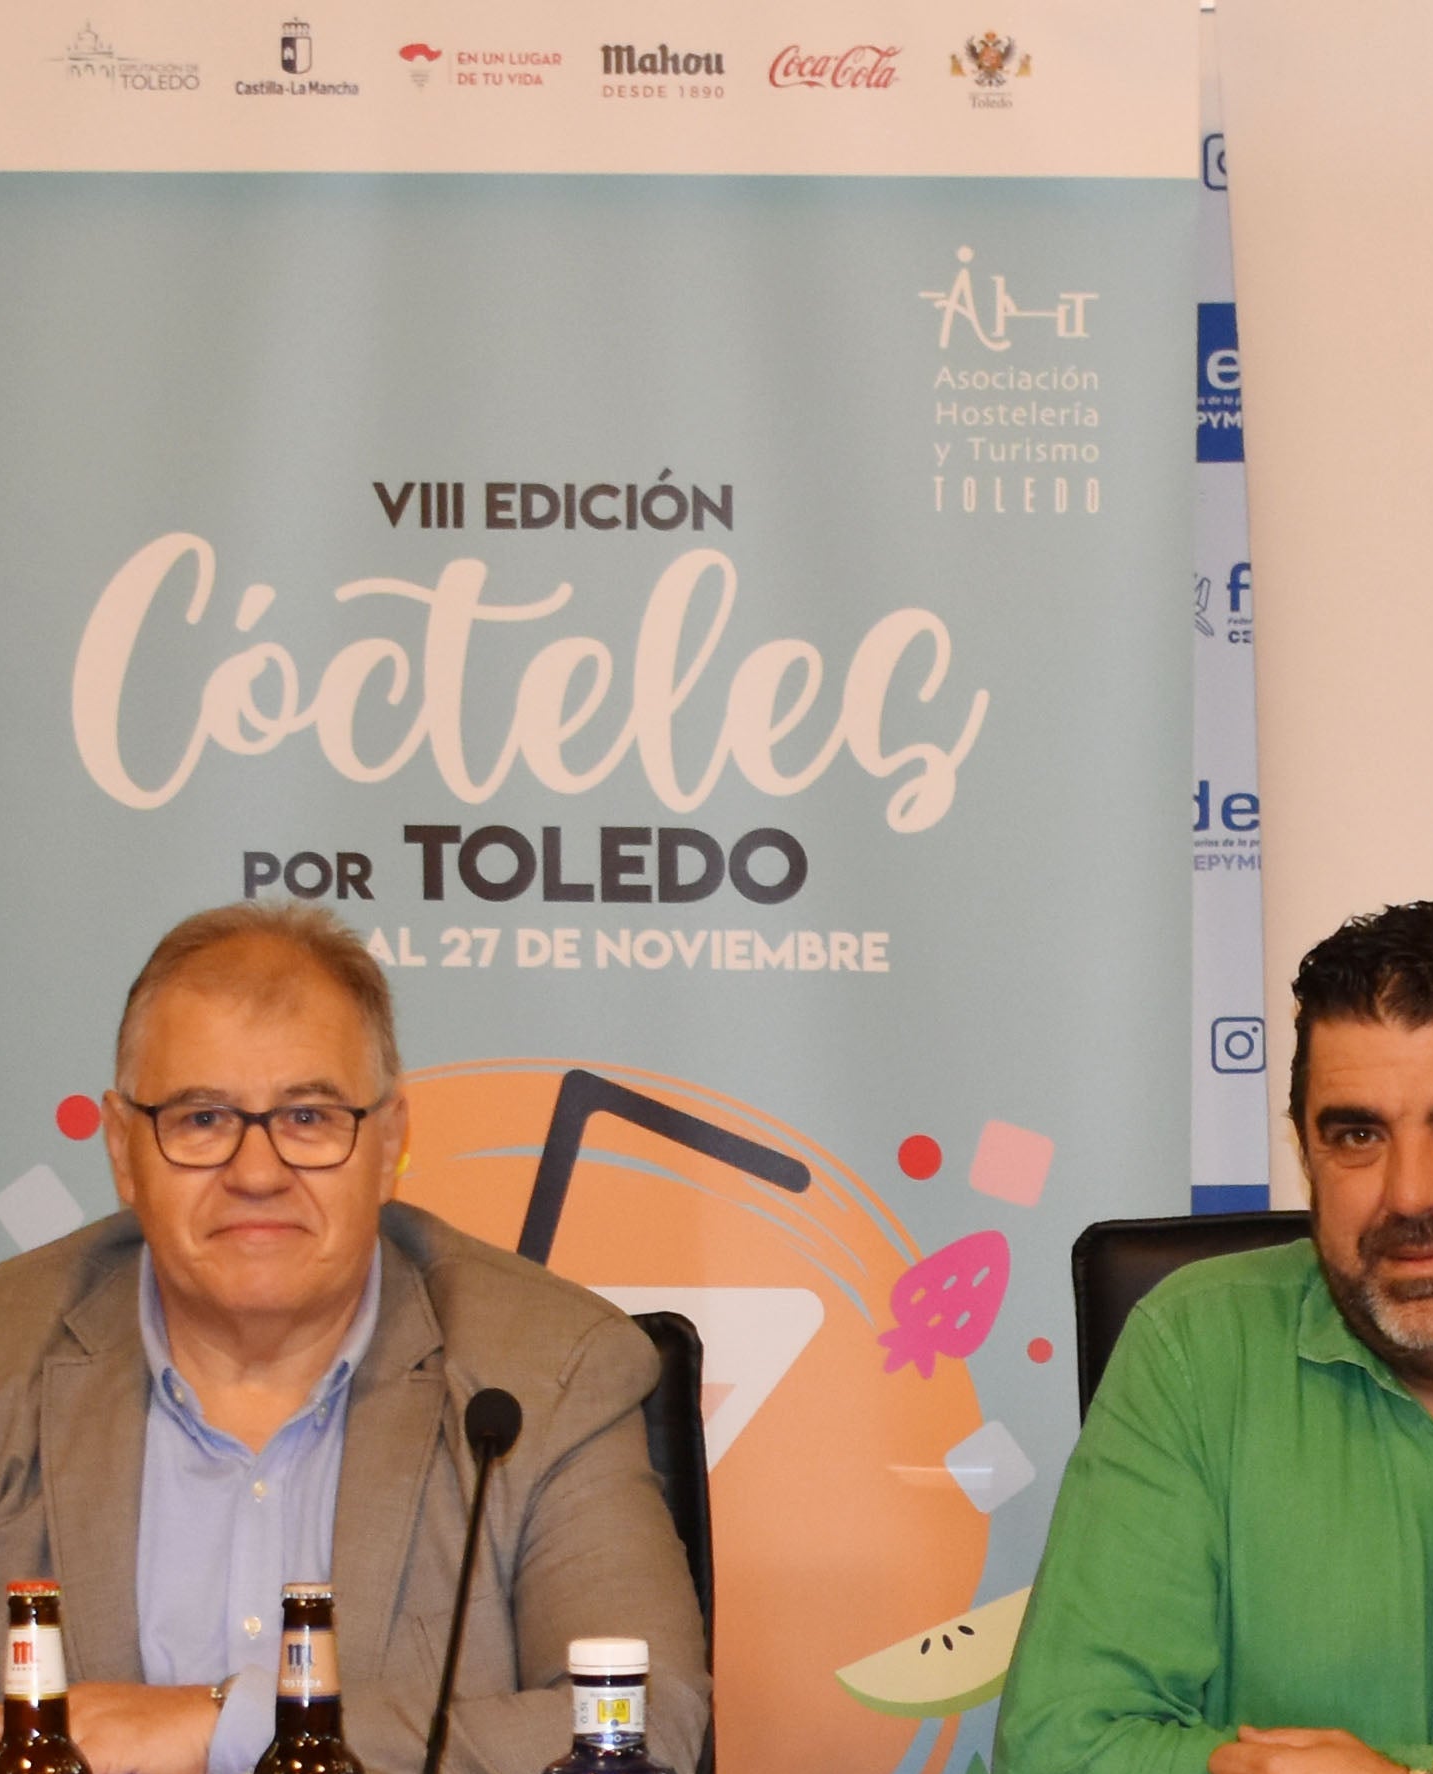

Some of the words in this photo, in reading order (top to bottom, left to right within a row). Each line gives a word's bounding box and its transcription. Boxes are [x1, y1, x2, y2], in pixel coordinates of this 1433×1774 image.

[457, 52, 478, 64] EN
[482, 52, 504, 65] UN
[509, 52, 562, 65] LUGAR
[601, 44, 724, 75] Mahou
[768, 44, 905, 89] Coca-Cola
[121, 74, 200, 91] TOLEDO
[308, 81, 360, 96] Mancha
[457, 72, 477, 85] DE
[482, 72, 503, 86] TU
[507, 73, 543, 86] VIDA
[602, 85, 666, 98] DESDE
[679, 85, 724, 99] 1890
[934, 365, 1098, 391] Asociación
[936, 402, 1099, 427] Hostelería
[934, 443, 950, 467] y
[967, 437, 1099, 463] Turismo
[373, 482, 464, 528] VIII
[485, 468, 732, 530] EDICIÓN
[934, 476, 1100, 514] TOLEDO
[71, 532, 990, 834] Cócteles
[244, 852, 374, 900] POR
[404, 825, 807, 904] TOLEDO
[369, 928, 428, 968] AL
[441, 927, 501, 968] 27
[517, 928, 581, 968] DE
[596, 929, 889, 971] NOVIEMBRE
